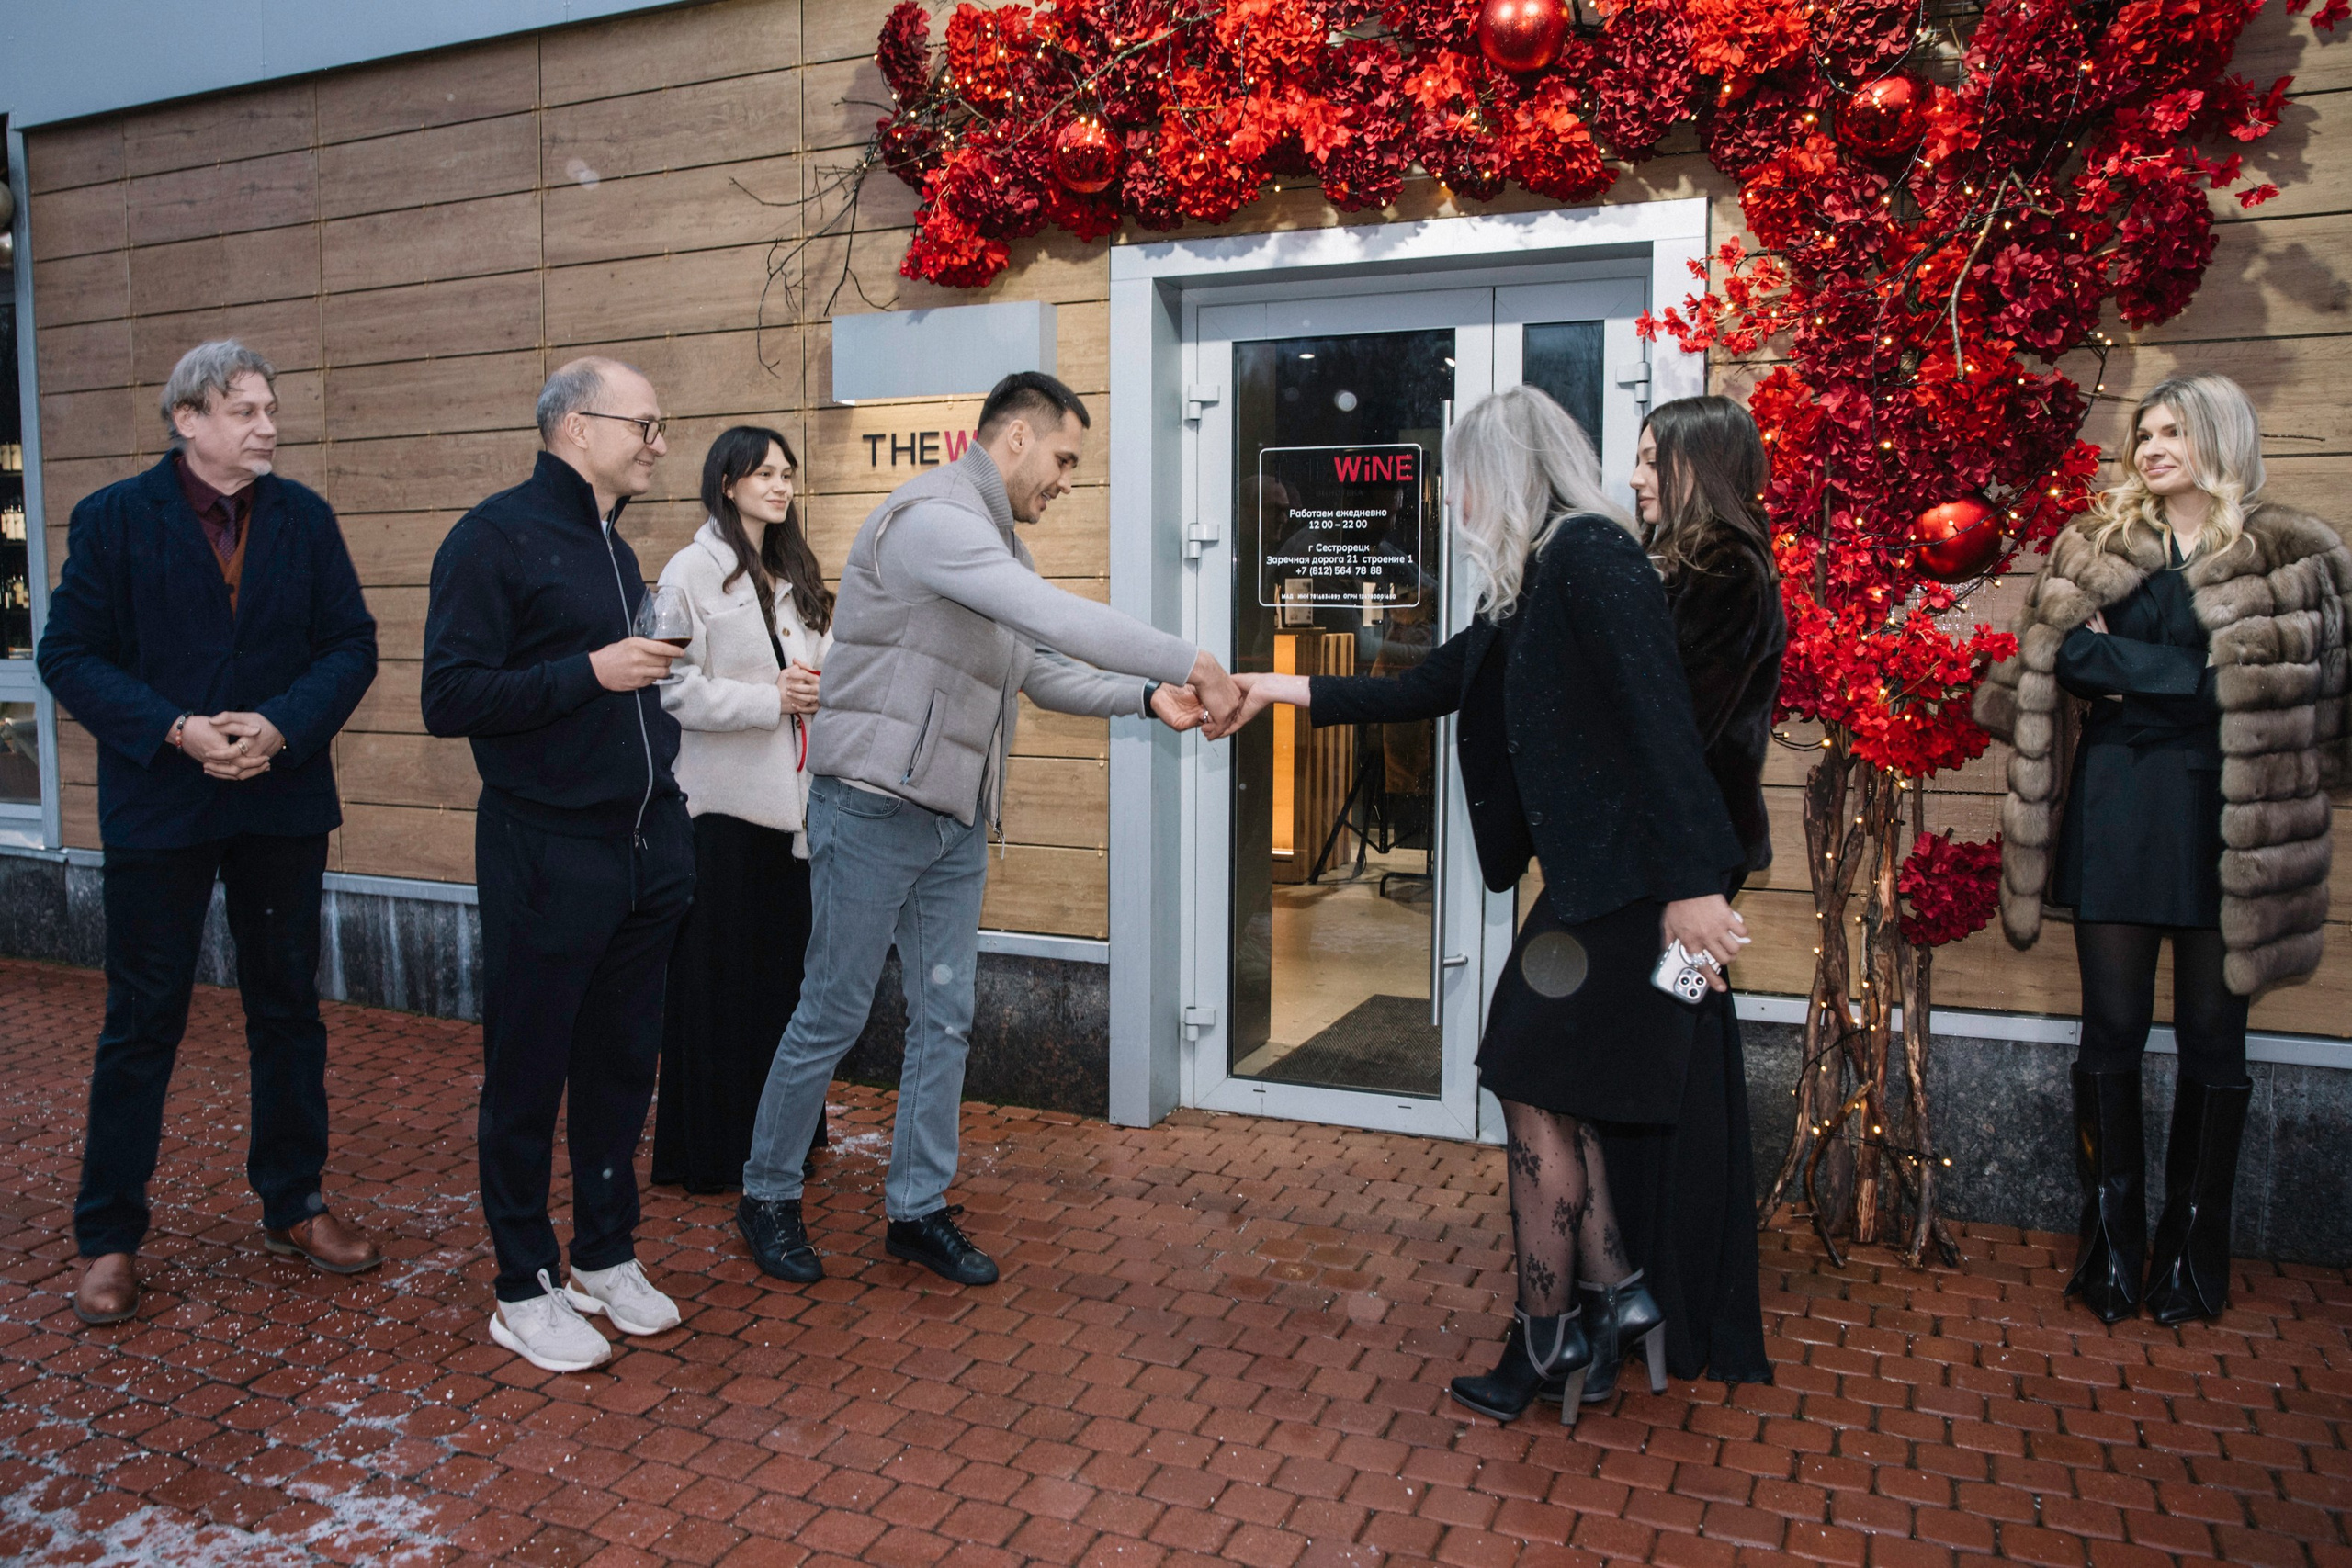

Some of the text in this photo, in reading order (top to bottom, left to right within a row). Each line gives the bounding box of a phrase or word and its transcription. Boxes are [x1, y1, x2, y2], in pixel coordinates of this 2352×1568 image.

[1290, 508, 1387, 518] Работаем ежедневно
[1317, 543, 1370, 554] Сестрорецк
[1266, 555, 1413, 566] Заречная дорога 21 строение 1
[1296, 566, 1381, 576] +7 (812) 564 78 88
